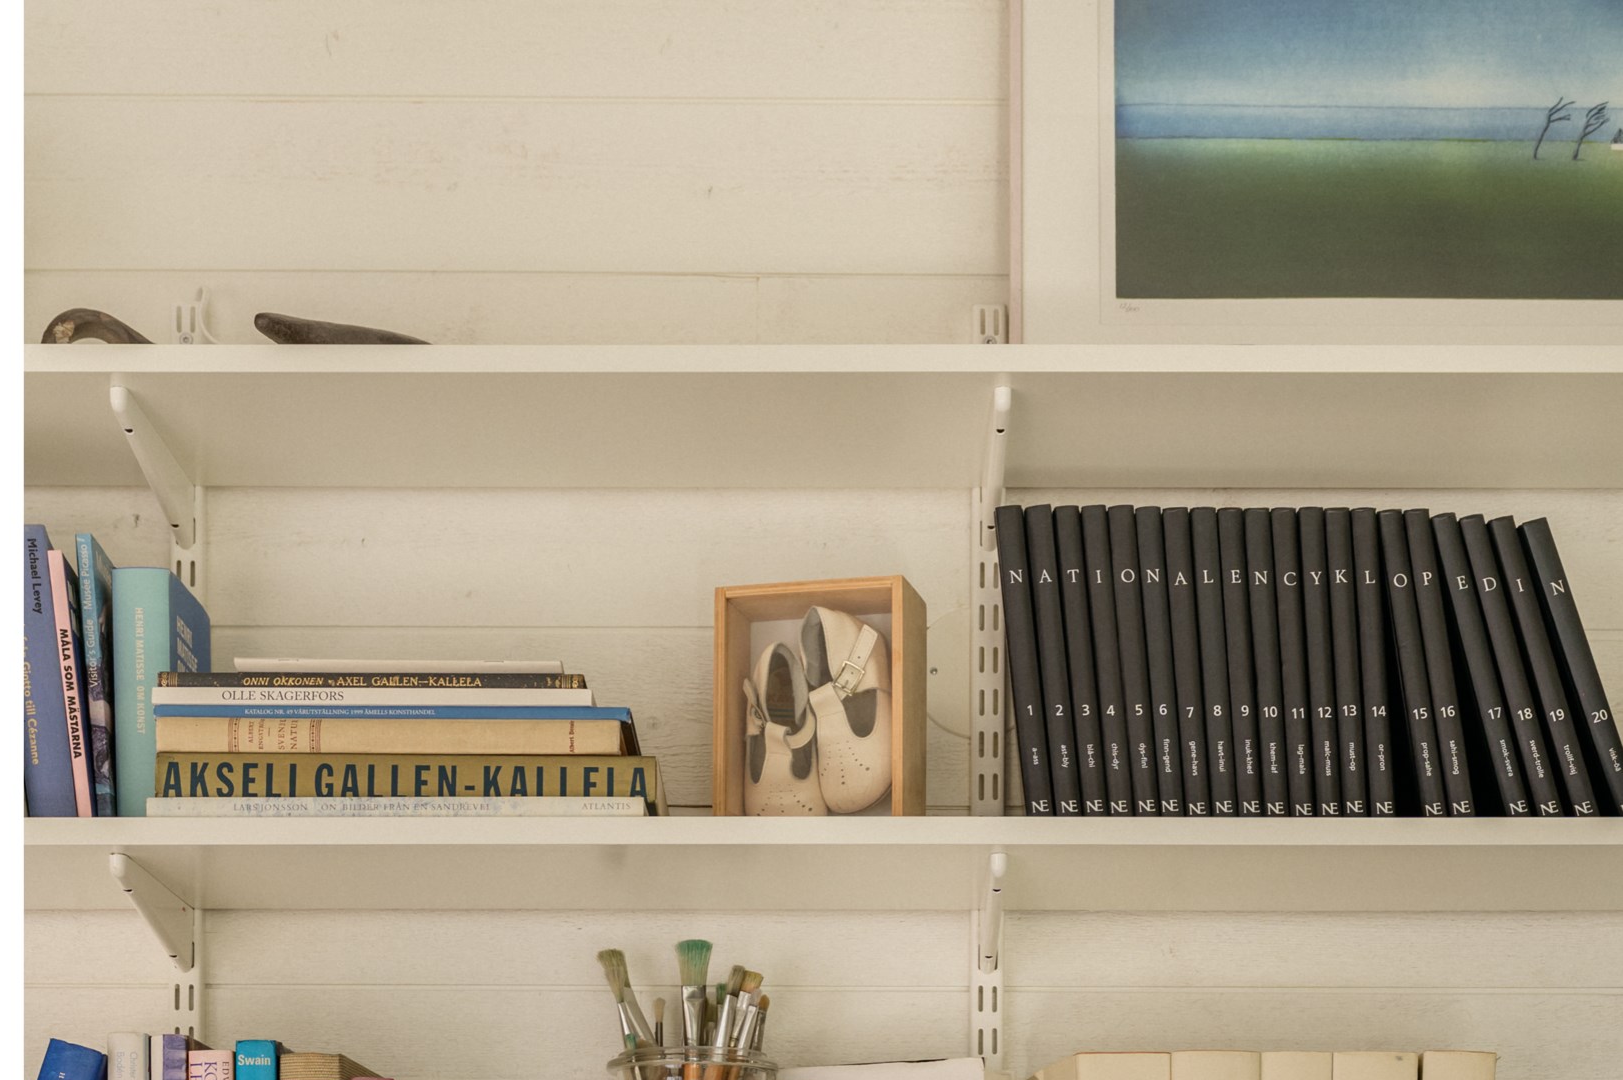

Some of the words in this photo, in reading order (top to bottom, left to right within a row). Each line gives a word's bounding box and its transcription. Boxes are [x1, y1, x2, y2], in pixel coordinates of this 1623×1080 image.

[27, 538, 41, 580] Michael
[80, 544, 90, 577] Picasso
[32, 583, 43, 614] Levey
[84, 579, 93, 610] Musée
[135, 607, 144, 637] HENRI
[86, 618, 96, 648] Guide
[59, 628, 71, 661] MÅLA
[88, 648, 99, 688] Visitor's
[135, 640, 145, 681] MATISSE
[63, 665, 75, 692] SOM
[243, 677, 270, 686] ONNI
[273, 676, 324, 686] OKKONEN
[336, 676, 366, 686] AXEL
[137, 686, 145, 701] OM
[222, 690, 256, 701] OLLE
[260, 690, 344, 701] SKAGERFORS
[25, 699, 37, 716] till
[293, 707, 349, 716] VÅRUTSTÄLLNING
[364, 707, 388, 716] ÅMELLS
[389, 708, 436, 716] KONSTHANDEL
[1027, 704, 1033, 717] 1
[1106, 704, 1115, 716] 4
[1186, 706, 1195, 718] 7
[1263, 706, 1278, 718] 10
[1317, 706, 1332, 718] 12
[1412, 707, 1428, 720] 15
[1487, 706, 1502, 721] 17
[136, 702, 146, 735] KONST
[1591, 708, 1609, 724] 20
[67, 694, 82, 759] MÄSTARNA
[27, 718, 39, 765] Cézanne
[162, 761, 297, 798] AKSELI
[233, 803, 258, 811] LARS
[258, 803, 308, 812] JONSSON
[581, 802, 631, 811] ATLANTIS
[1032, 799, 1049, 814] NE
[1215, 800, 1233, 814] NE
[1509, 800, 1528, 815] NE
[237, 1054, 271, 1067] Swain
